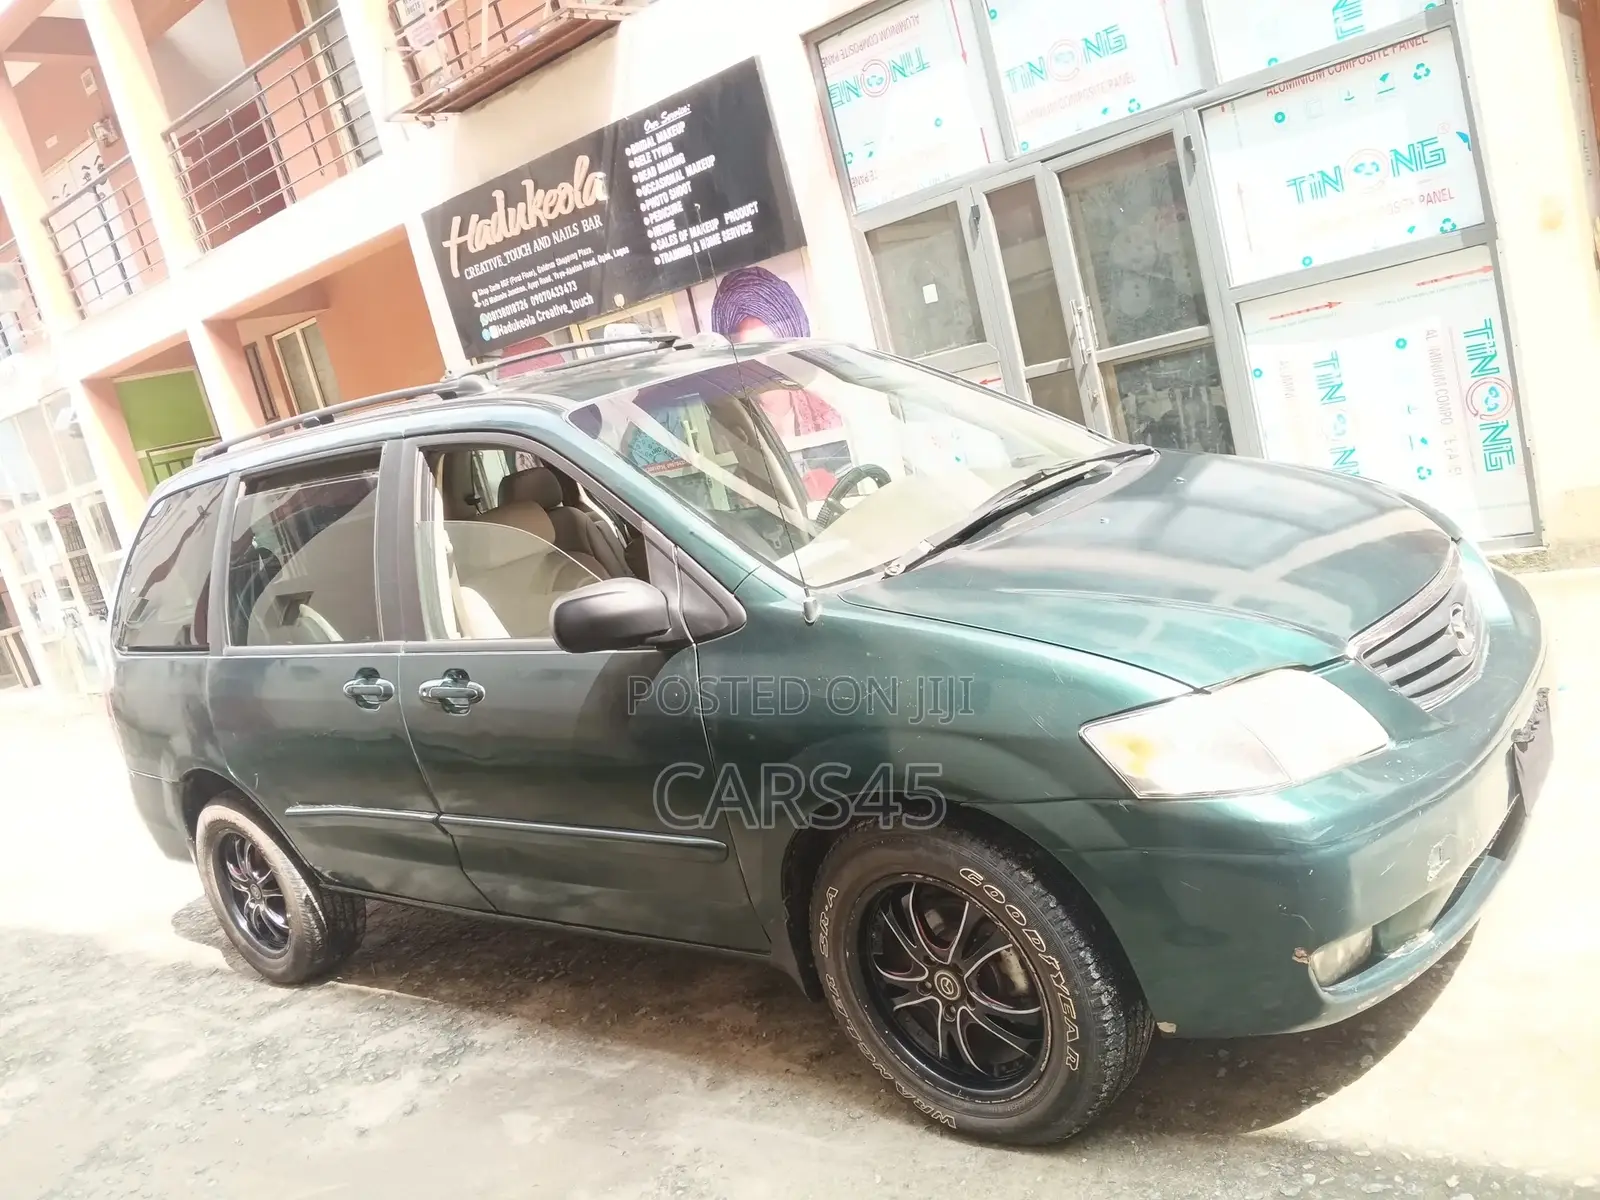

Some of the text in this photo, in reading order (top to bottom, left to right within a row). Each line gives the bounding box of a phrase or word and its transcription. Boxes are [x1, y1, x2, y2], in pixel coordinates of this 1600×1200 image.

[820, 52, 839, 68] PANE
[630, 121, 685, 155] BRIDAL MAKEUP
[641, 154, 715, 196] OCCASIONAL MAKEUP
[657, 152, 686, 174] MAKING
[850, 172, 869, 187] PANE
[645, 181, 692, 210] PHOTO SHOOT
[1418, 186, 1455, 207] PANEL
[442, 155, 609, 278] Hadukeola
[649, 201, 683, 224] PEDICURE
[656, 201, 758, 250] SALES OF MAKEUP PRODUCT
[533, 236, 551, 252] AND
[552, 222, 579, 244] NAILS
[581, 214, 603, 232] BAR
[659, 221, 753, 264] TRAINING & HOME SERVICE
[582, 257, 598, 269] Road,
[612, 246, 629, 258] Lagos
[959, 868, 1081, 1071] GOODYEAR
